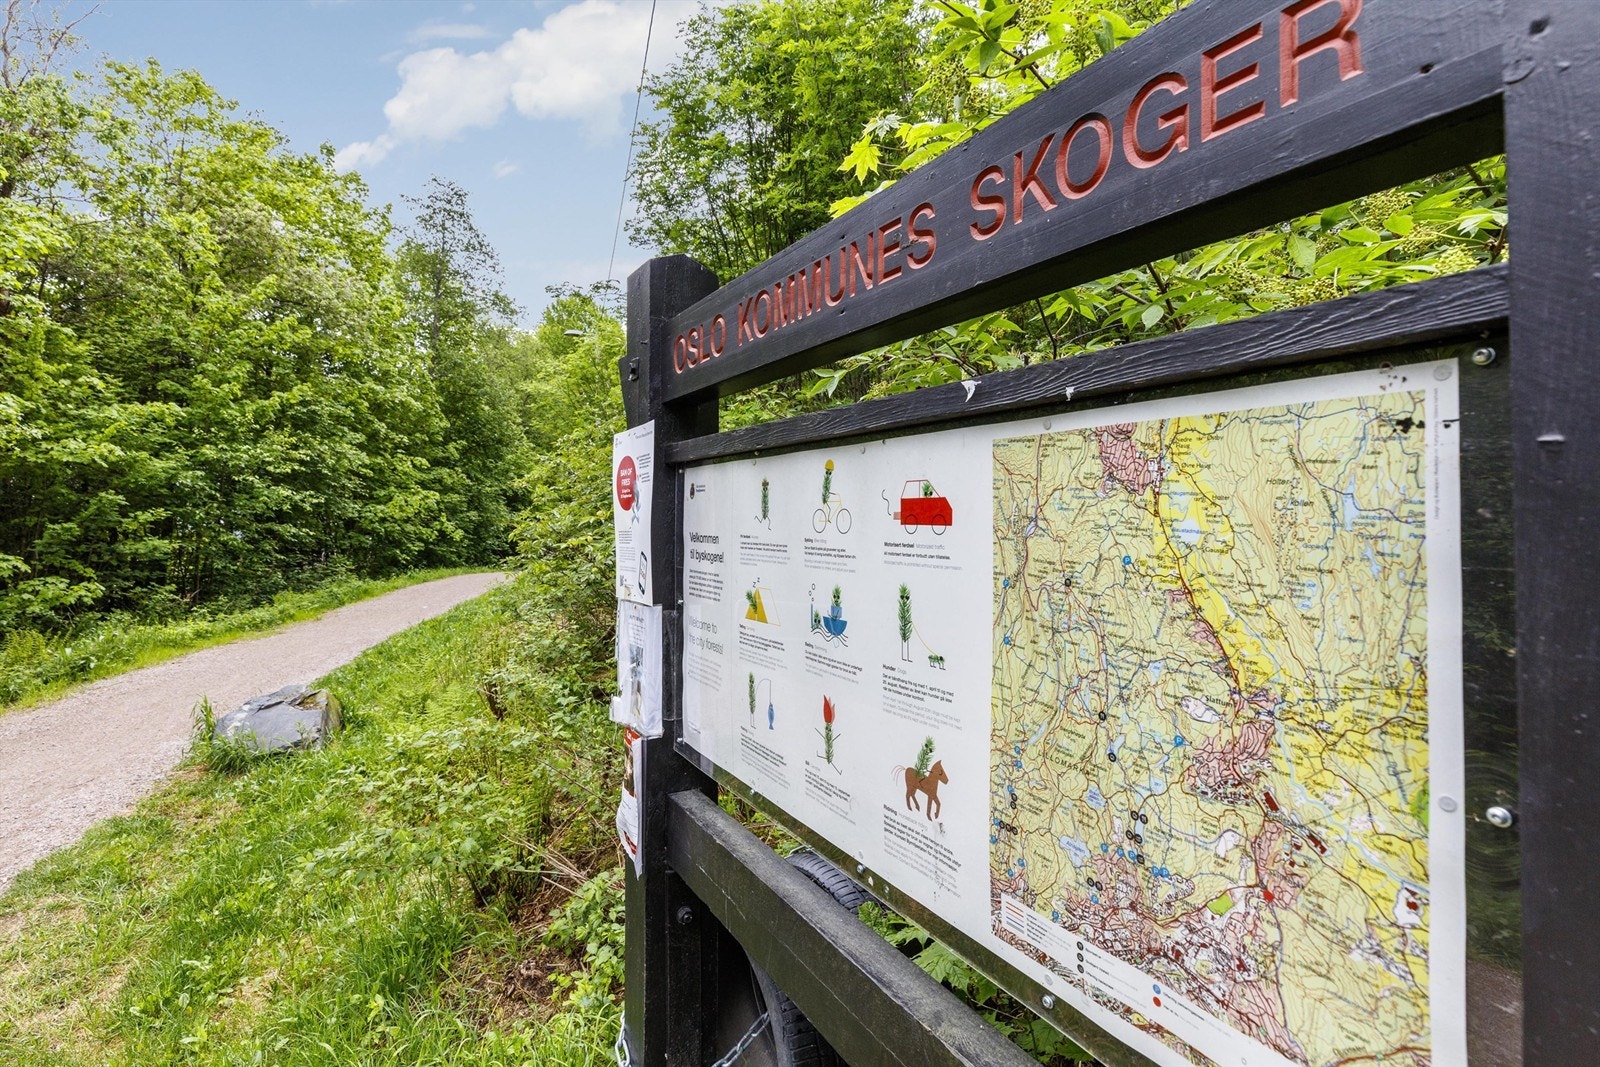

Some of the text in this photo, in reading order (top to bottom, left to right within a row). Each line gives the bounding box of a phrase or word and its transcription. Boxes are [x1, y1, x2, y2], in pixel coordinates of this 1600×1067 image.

[673, 0, 1365, 375] OSLO KOMMUNES SKOGER
[689, 532, 719, 544] Velkommen
[696, 550, 724, 564] byskogene!
[688, 615, 717, 634] Welcome to
[1205, 694, 1233, 707] Slattum
[883, 804, 897, 815] Ridning
